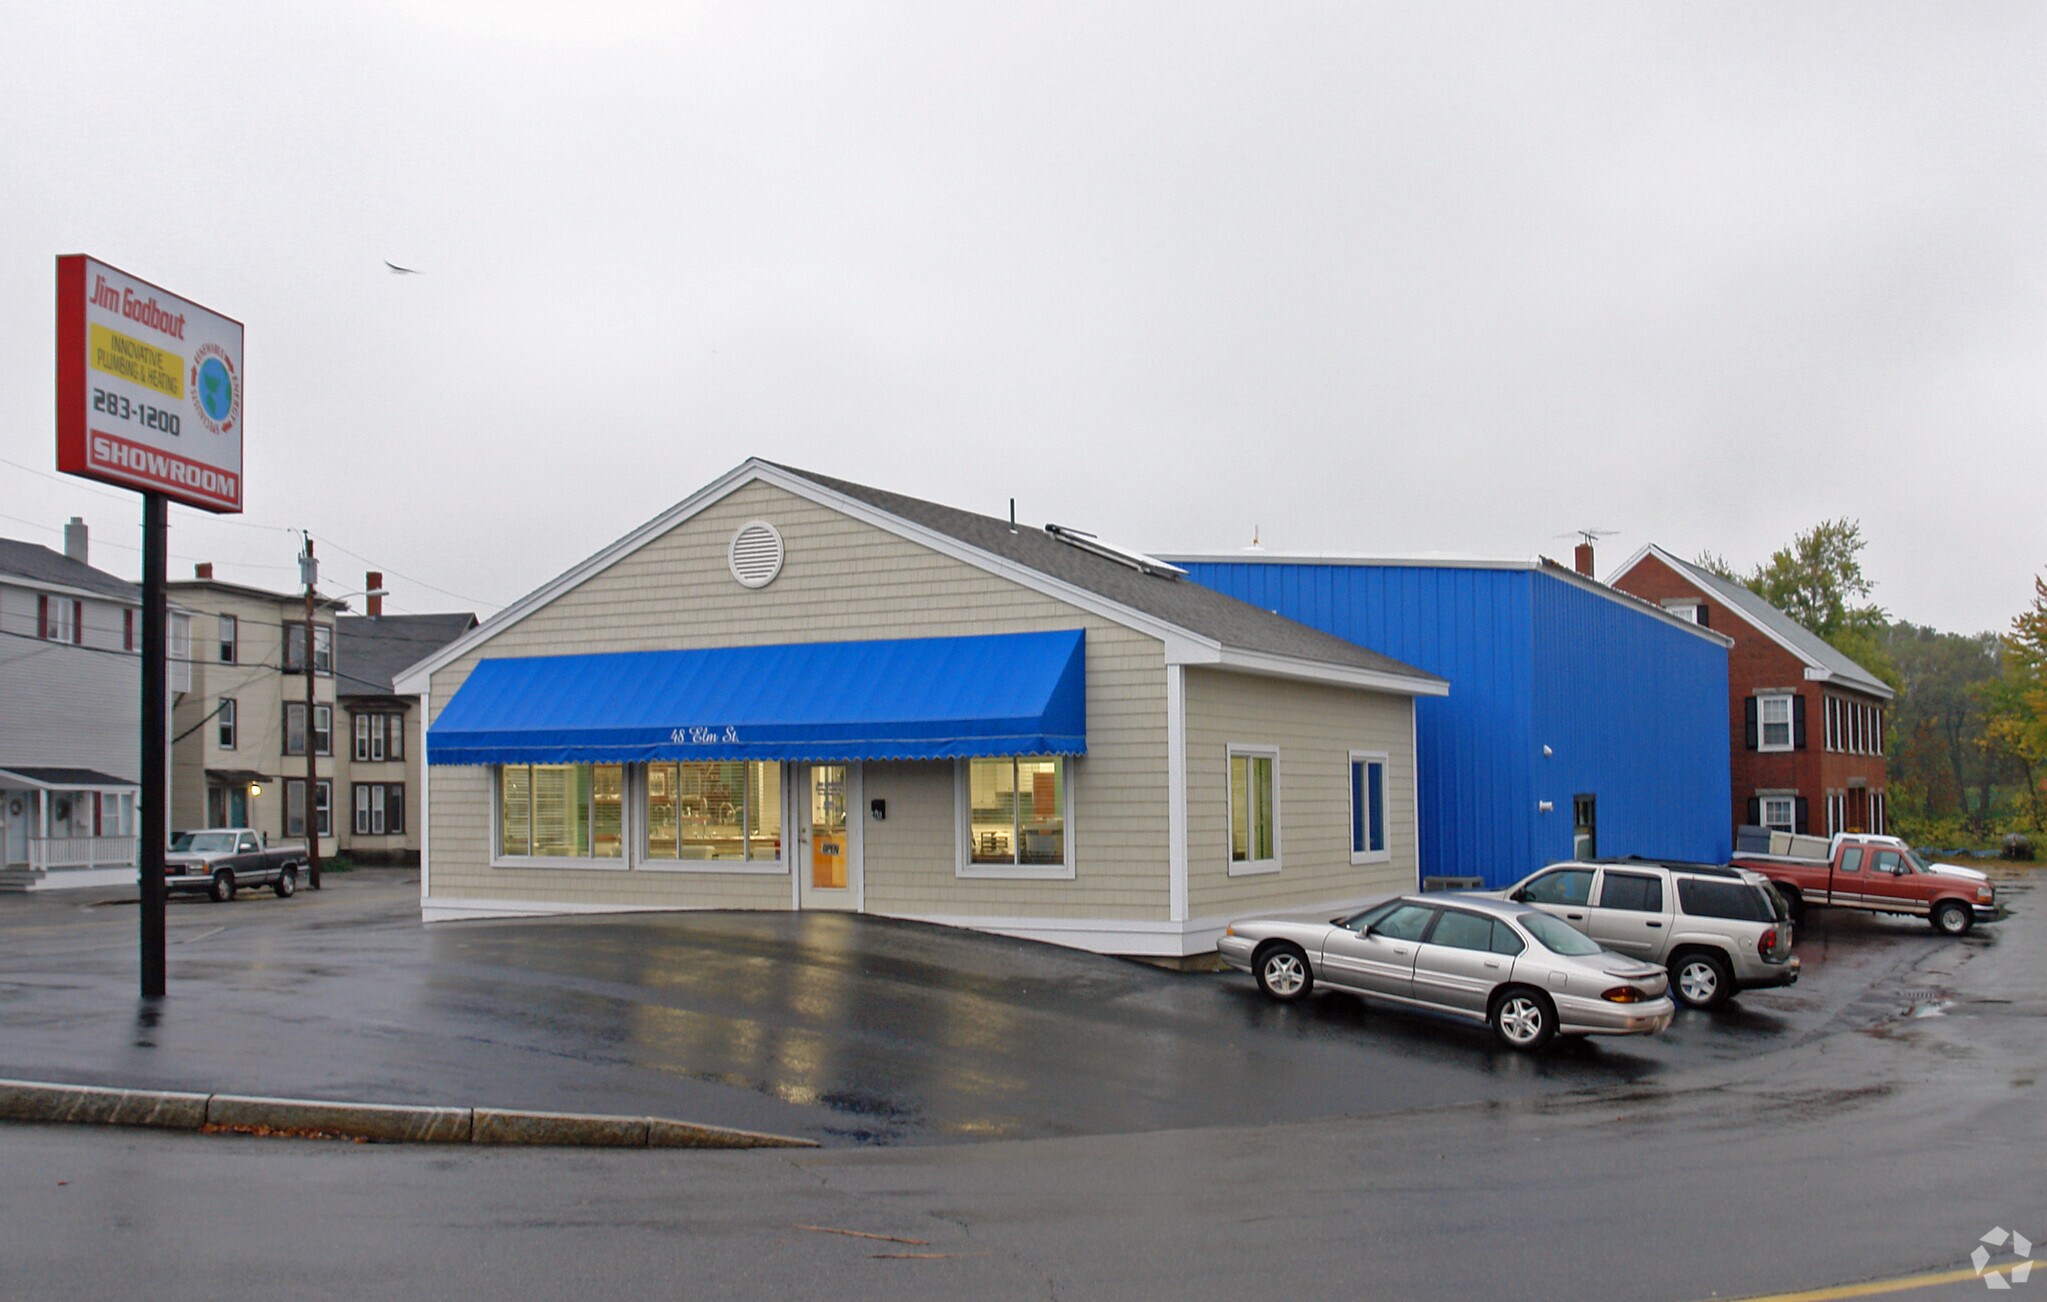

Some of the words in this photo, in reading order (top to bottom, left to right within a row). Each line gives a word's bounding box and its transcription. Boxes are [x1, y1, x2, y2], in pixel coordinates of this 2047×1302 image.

[89, 274, 120, 313] Jim
[122, 286, 185, 340] Godbout
[97, 348, 139, 379] PLUMBING
[140, 364, 147, 382] &
[147, 366, 178, 394] HEATING
[111, 335, 163, 370] INNOVATIVE
[93, 387, 180, 437] 283-1200
[93, 436, 235, 499] SHOWROOM
[671, 728, 685, 744] 48
[689, 726, 718, 744] Elm
[822, 843, 840, 855] OPEN
